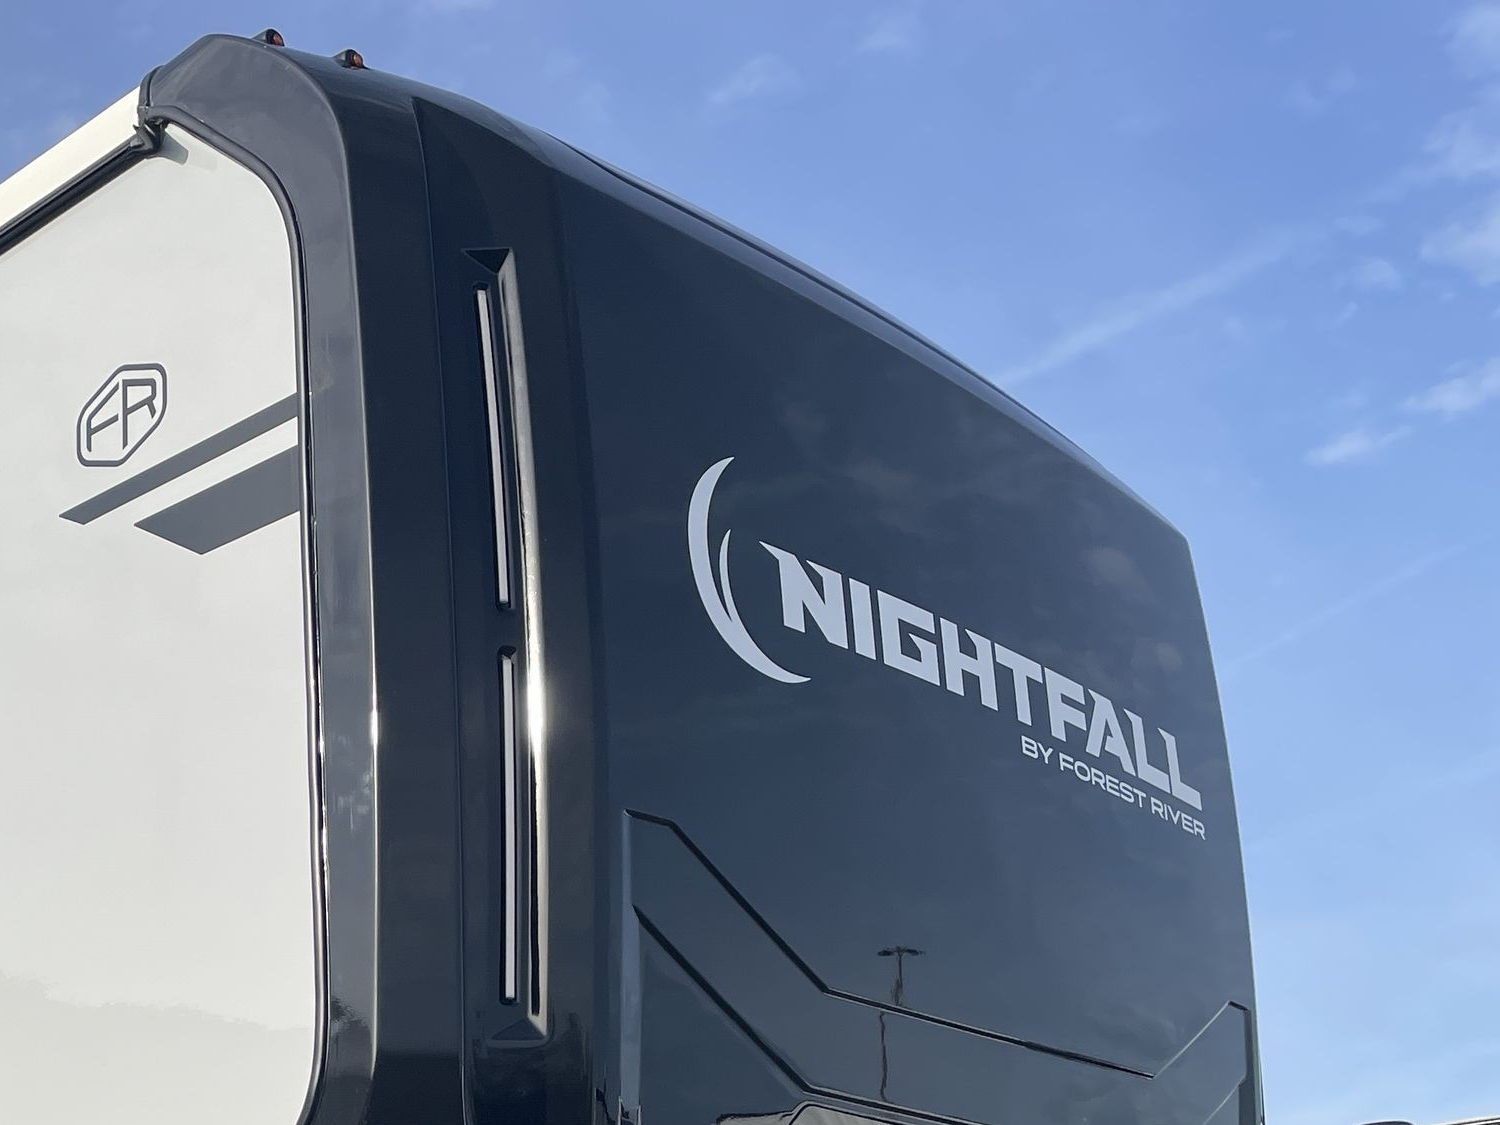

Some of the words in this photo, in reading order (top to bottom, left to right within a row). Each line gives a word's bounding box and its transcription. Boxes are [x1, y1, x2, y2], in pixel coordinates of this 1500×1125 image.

[758, 540, 1203, 811] NIGHTFALL
[1021, 735, 1054, 764] BY
[1059, 752, 1147, 808] FOREST
[1150, 797, 1206, 841] RIVER
